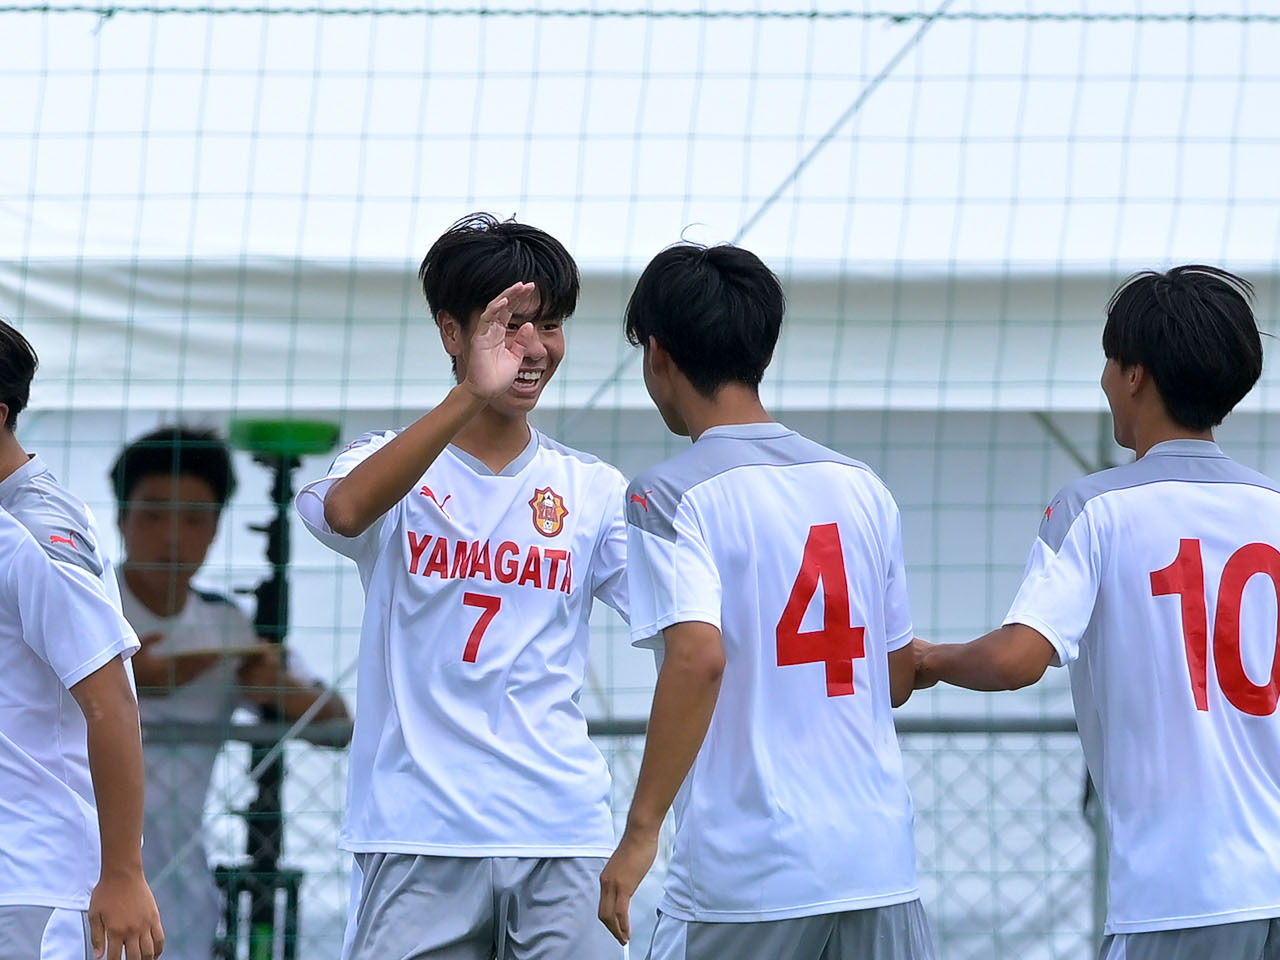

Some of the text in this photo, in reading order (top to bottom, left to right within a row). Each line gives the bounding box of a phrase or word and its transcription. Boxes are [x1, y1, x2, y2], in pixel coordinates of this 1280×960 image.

[407, 531, 572, 594] YAMAGATA
[776, 522, 865, 697] 4
[462, 592, 502, 663] 7
[1149, 538, 1280, 716] 10
